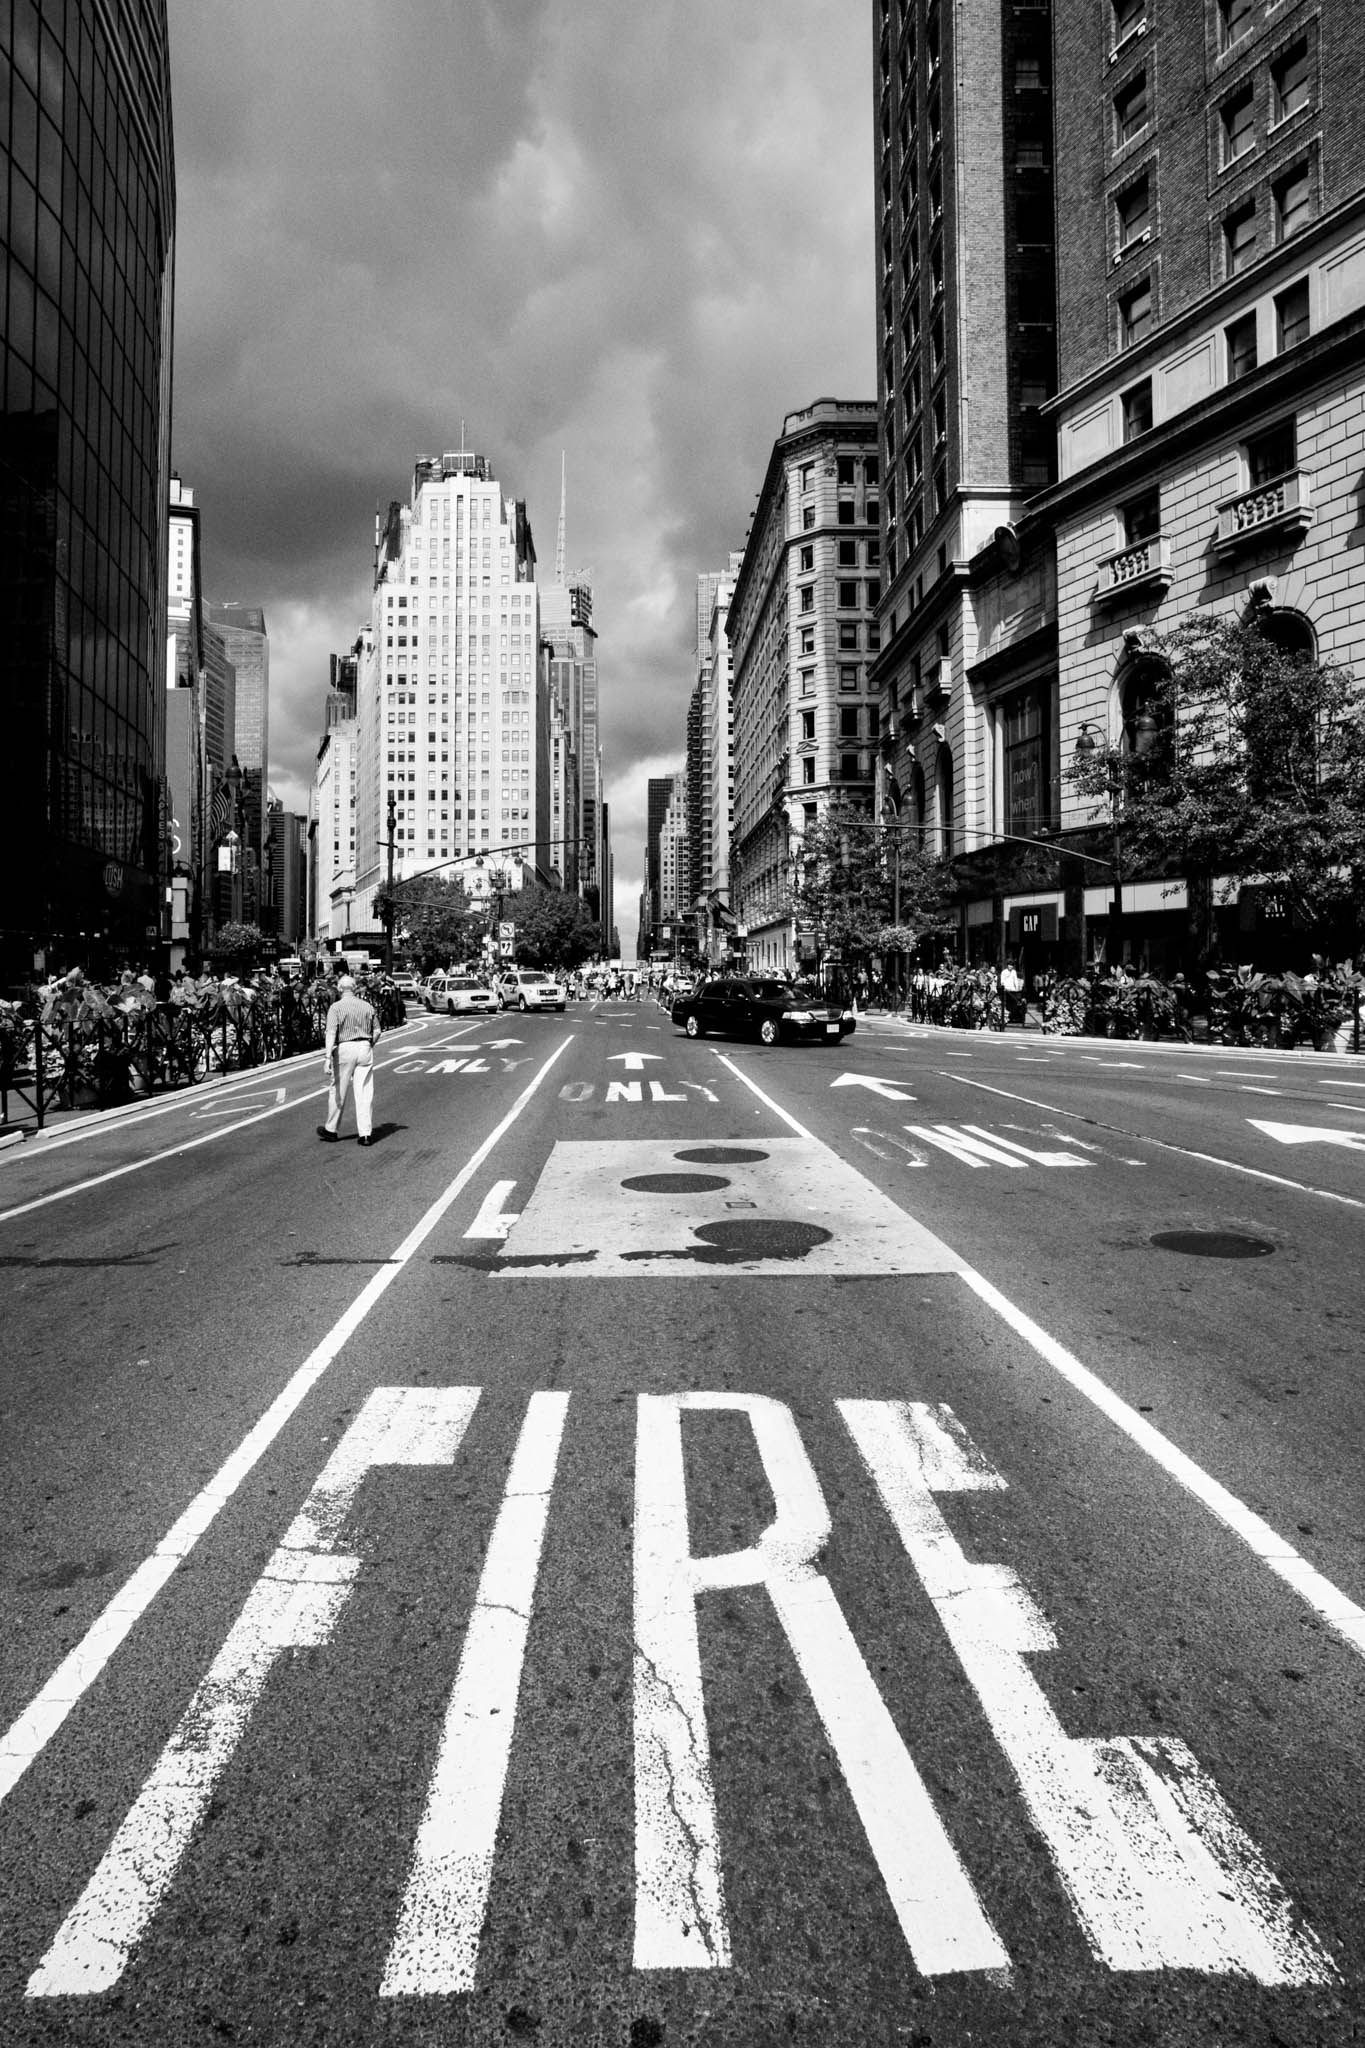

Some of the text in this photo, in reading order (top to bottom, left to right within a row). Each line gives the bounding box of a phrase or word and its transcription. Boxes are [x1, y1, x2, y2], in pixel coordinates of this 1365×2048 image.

[1013, 761, 1038, 785] now?
[158, 776, 166, 839] STAPLES
[104, 866, 124, 888] LUSH
[1023, 914, 1039, 932] GAP
[393, 1058, 535, 1074] ONLY
[558, 1080, 720, 1102] ONLY
[26, 1386, 1344, 1998] FIRE
